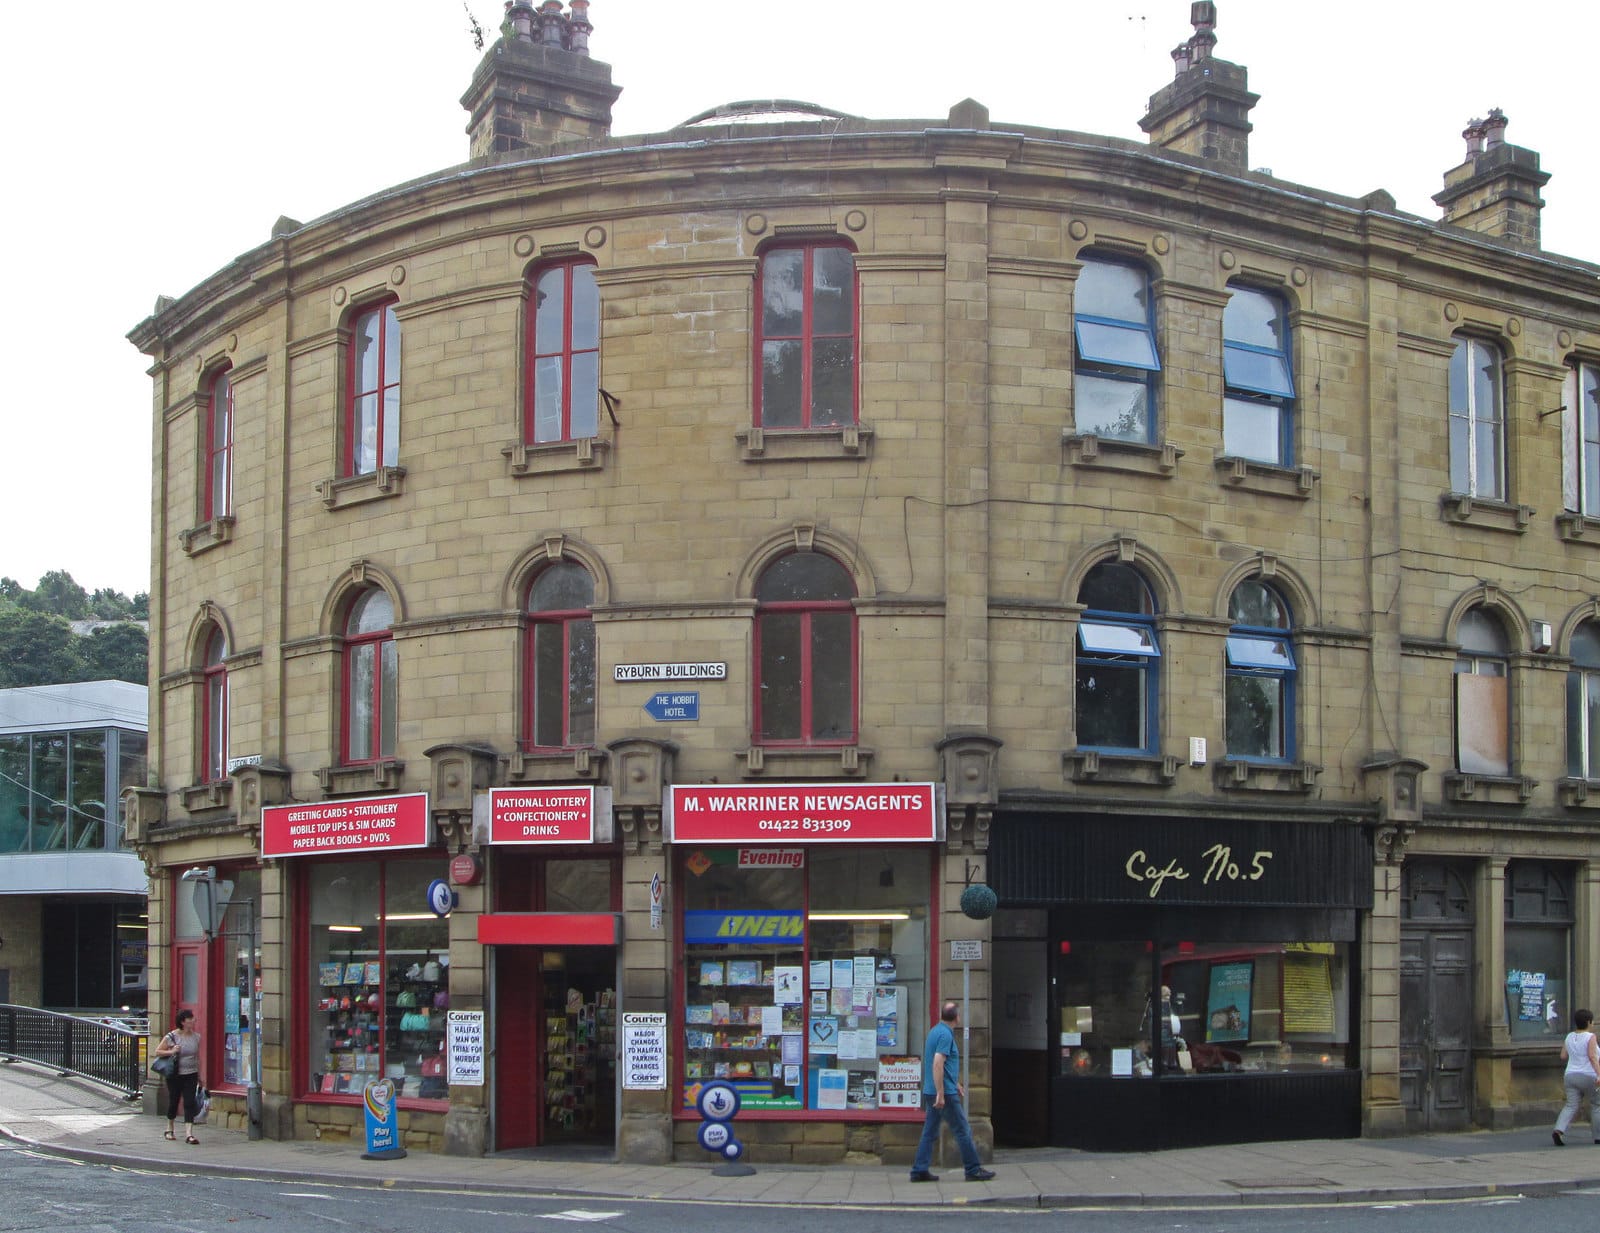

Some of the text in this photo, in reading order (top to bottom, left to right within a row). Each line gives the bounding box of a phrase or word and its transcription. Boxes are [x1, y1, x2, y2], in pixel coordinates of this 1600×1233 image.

[616, 664, 723, 678] RYBURN BUILDINGS
[656, 695, 695, 705] THE HOBBIT
[664, 708, 686, 717] HOTEL
[496, 797, 587, 808] NATIONAL LOTTERY
[683, 795, 923, 812] M. WARRINER NEWSAGENTS
[288, 803, 398, 822] GREETING CARDS STATIONERY
[503, 811, 579, 822] CONFECTIONERY
[290, 817, 396, 835] MOBILE TOP UPS & SIM CARDS
[522, 825, 560, 836] DRINKS
[758, 818, 851, 832] 01422 831309
[293, 832, 390, 848] PAPER BACK BOOKS DVD's
[739, 850, 803, 868] Evening
[1126, 850, 1189, 898] Cafe
[449, 1012, 482, 1021] Courier
[624, 1014, 664, 1023] Courier
[454, 1055, 480, 1063] MURDER
[631, 1073, 660, 1081] Courier
